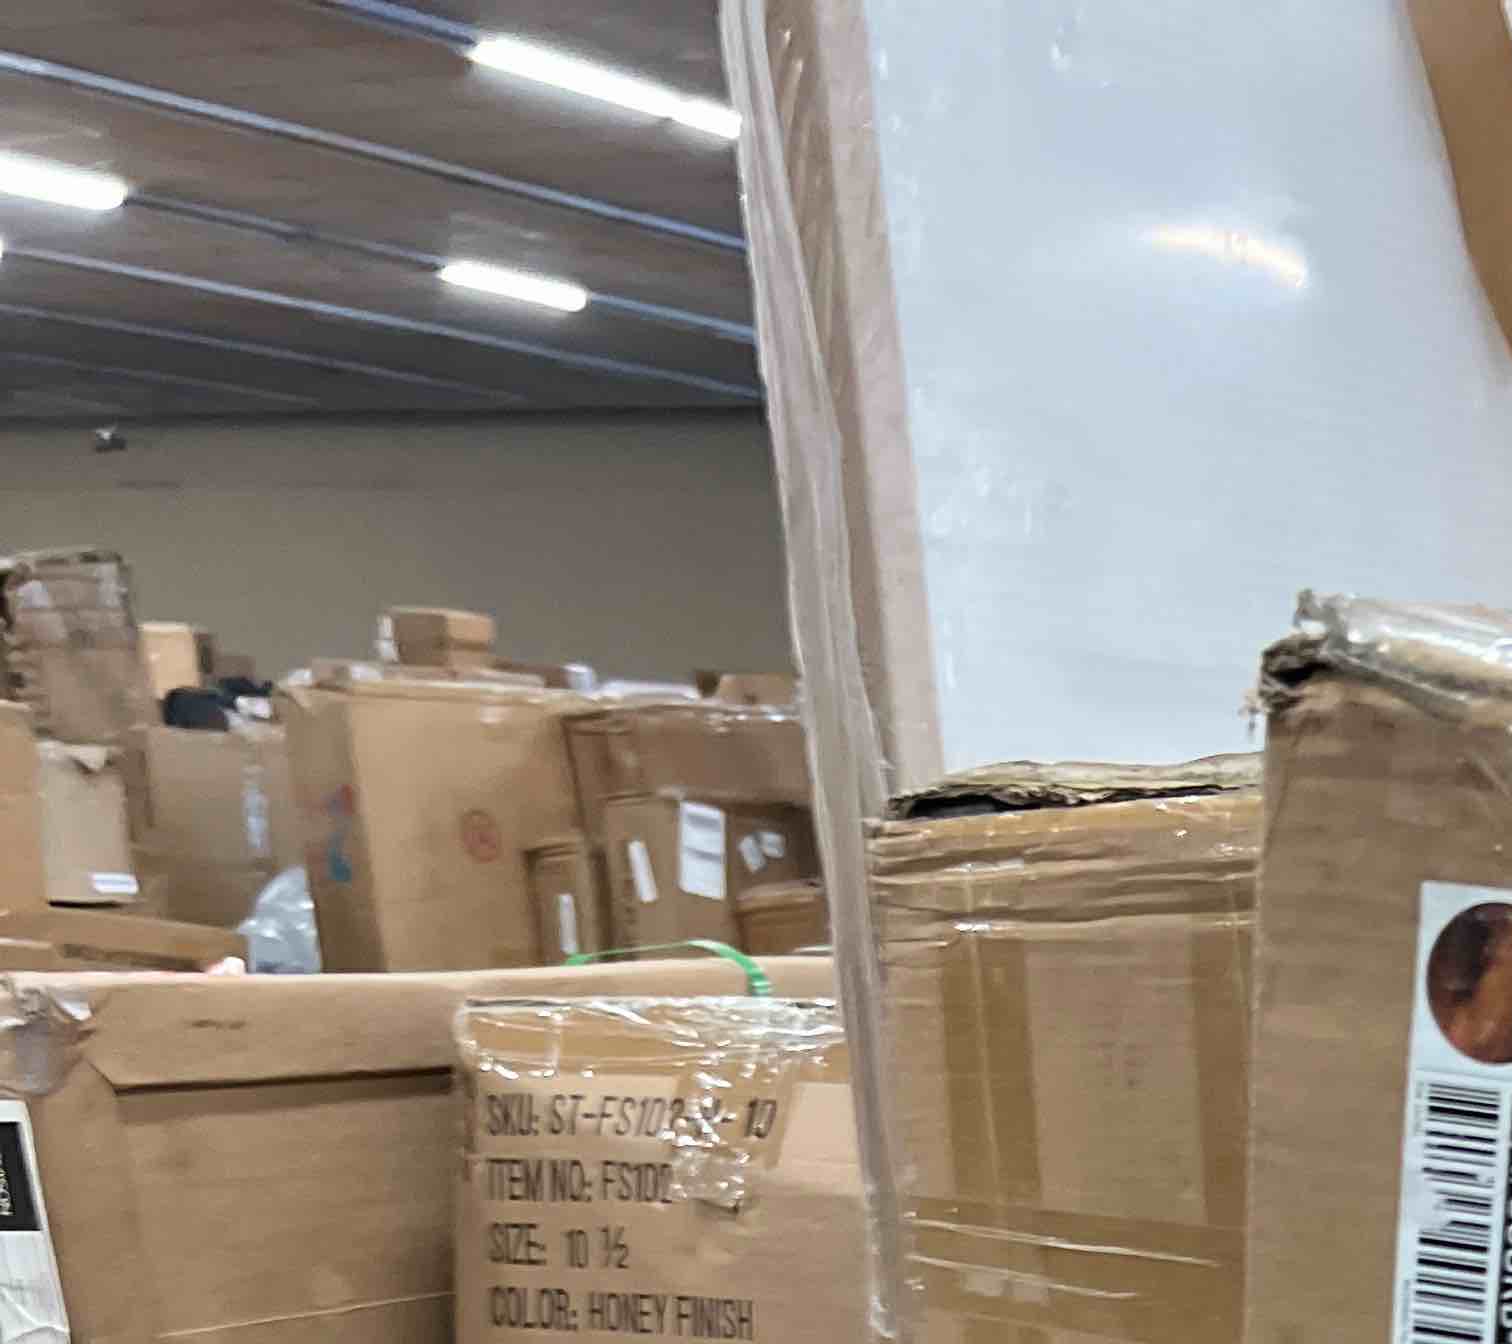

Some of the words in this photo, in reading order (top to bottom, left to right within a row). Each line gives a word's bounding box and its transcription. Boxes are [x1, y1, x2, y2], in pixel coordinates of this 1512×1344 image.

[487, 1094, 539, 1136] SKU:
[486, 1158, 544, 1202] ITEM
[551, 1159, 592, 1203] NO:
[488, 1222, 546, 1266] SIZE:
[564, 1228, 589, 1269] 10
[489, 1285, 578, 1331] COLOR:
[589, 1291, 666, 1334] HONEY
[671, 1295, 753, 1341] FINISH
